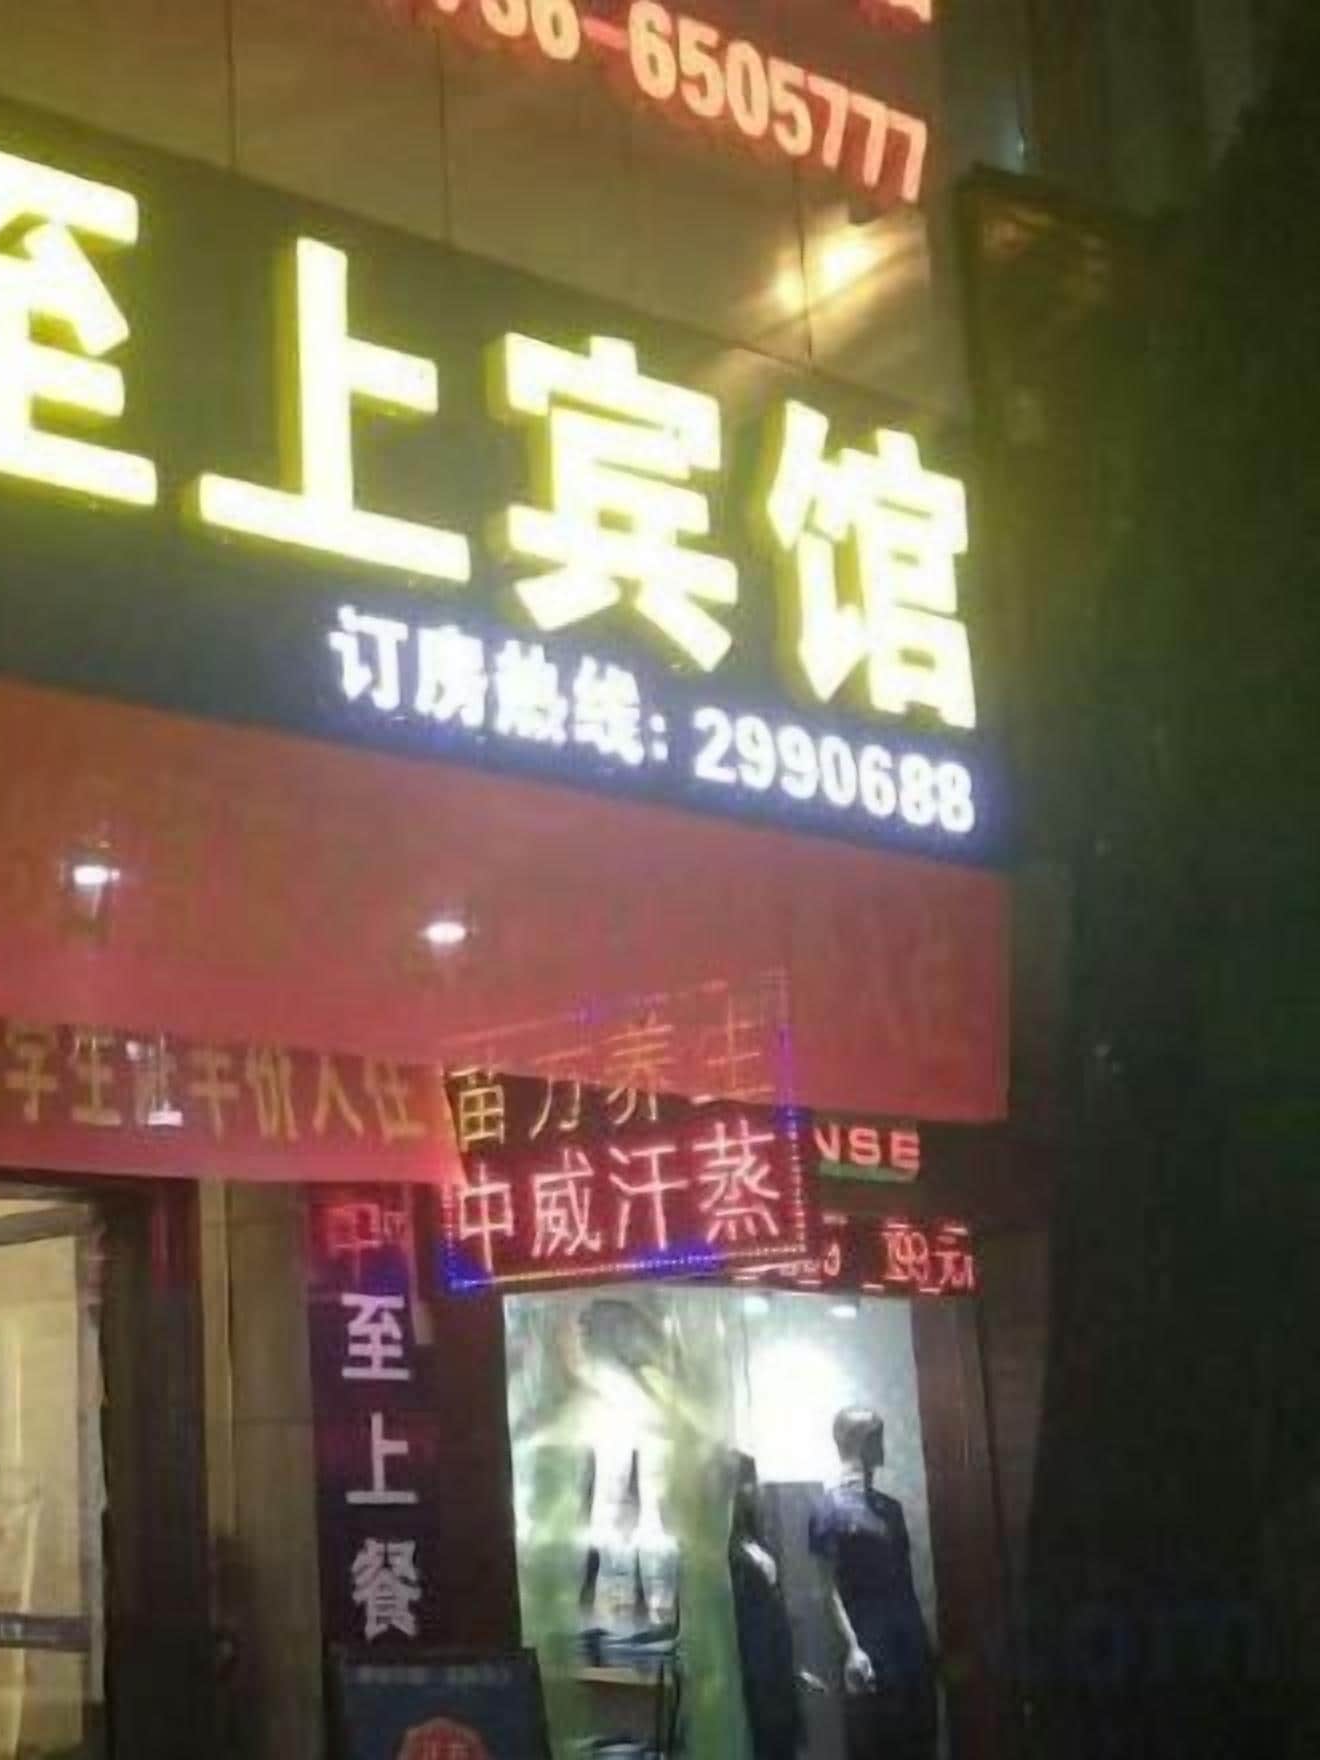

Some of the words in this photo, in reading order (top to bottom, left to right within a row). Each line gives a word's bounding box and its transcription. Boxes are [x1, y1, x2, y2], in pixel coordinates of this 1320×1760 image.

[437, 0, 928, 203] 6-6505777
[458, 1118, 781, 1276] 中威汗蒸
[340, 1293, 422, 1642] 至上餐
